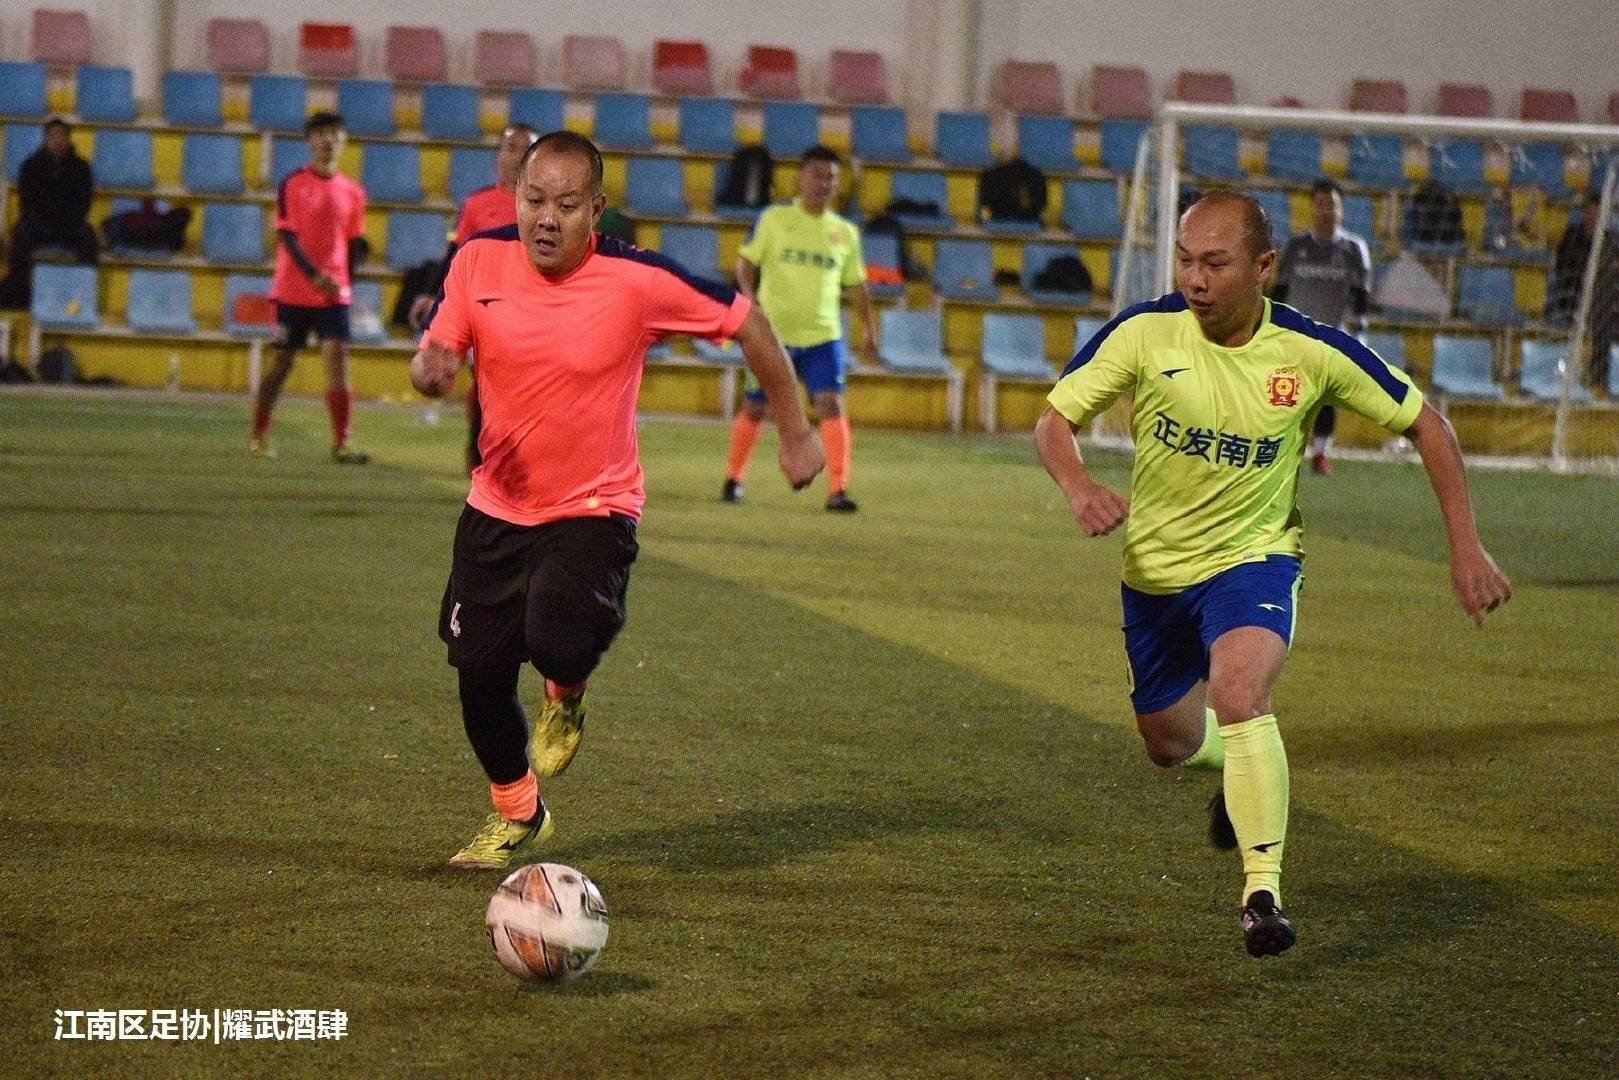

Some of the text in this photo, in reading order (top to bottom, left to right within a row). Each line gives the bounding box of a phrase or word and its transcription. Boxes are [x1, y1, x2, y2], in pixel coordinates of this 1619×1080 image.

[1153, 411, 1285, 469] 正发南尊
[450, 602, 462, 638] 4
